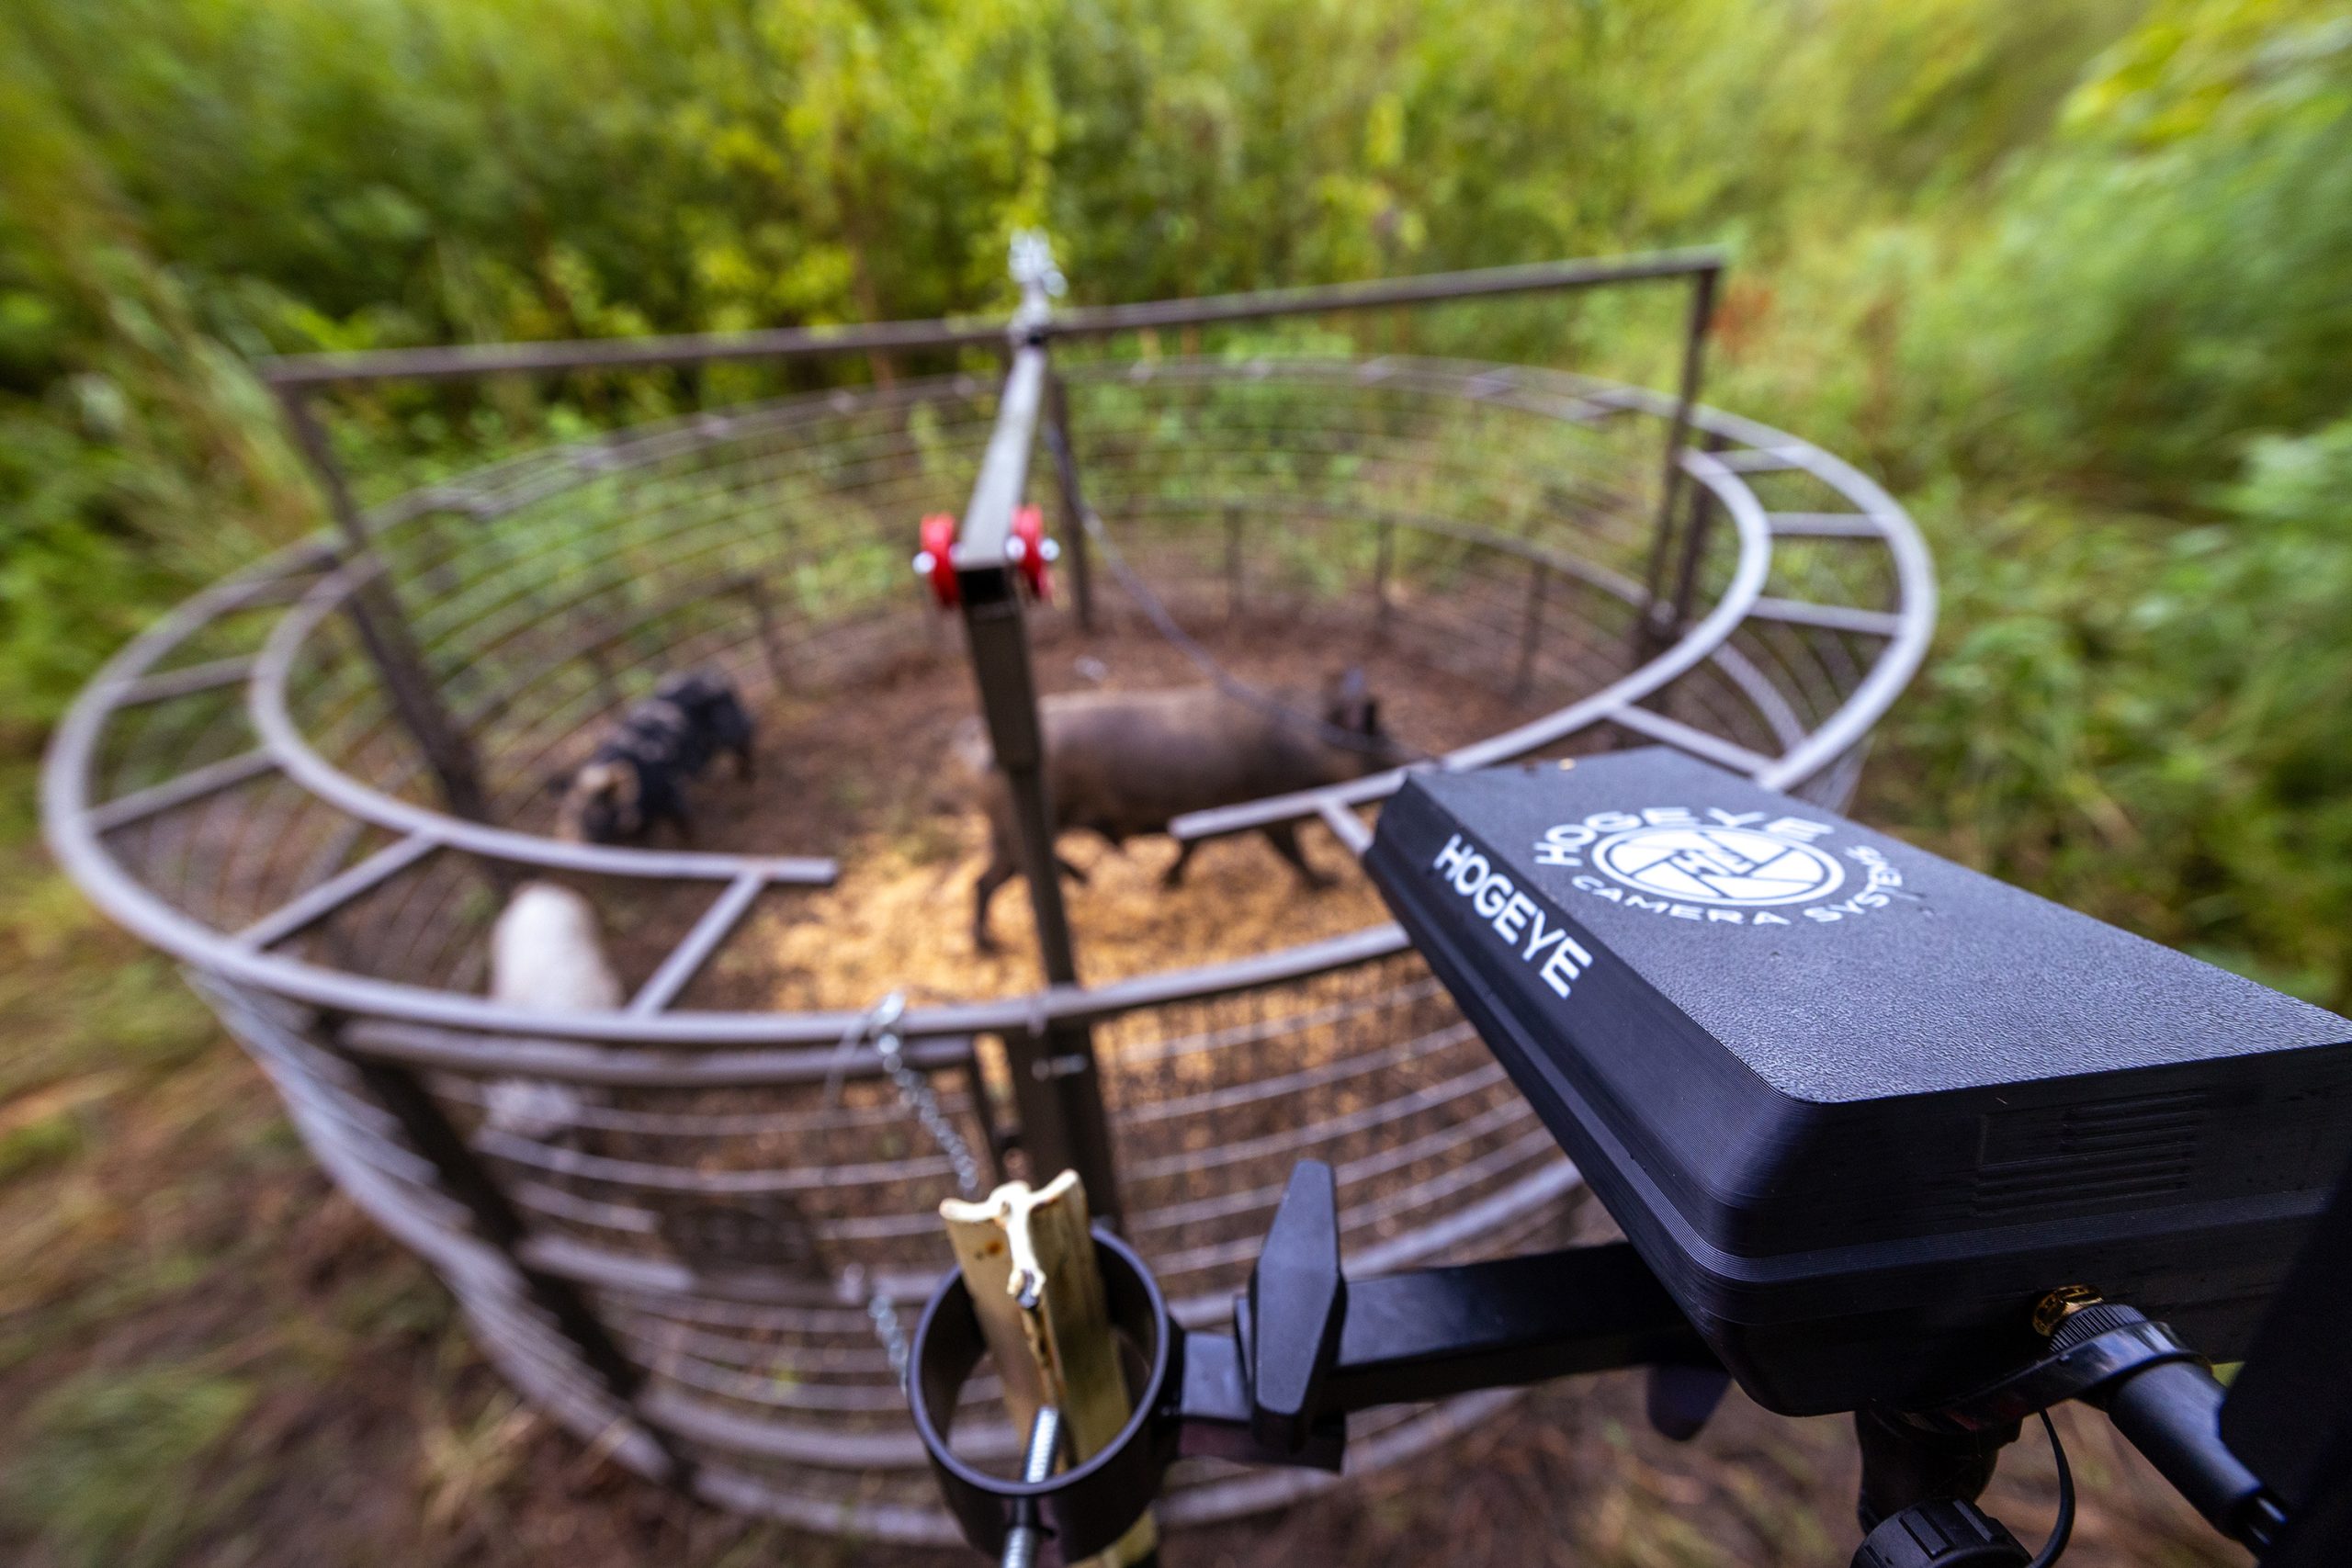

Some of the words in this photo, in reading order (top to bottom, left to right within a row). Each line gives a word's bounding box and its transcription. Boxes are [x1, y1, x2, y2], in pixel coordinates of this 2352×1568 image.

[1533, 807, 1835, 866] HOGEYE
[1432, 833, 1594, 999] HOGEYE
[1571, 875, 1791, 925] CAMERA
